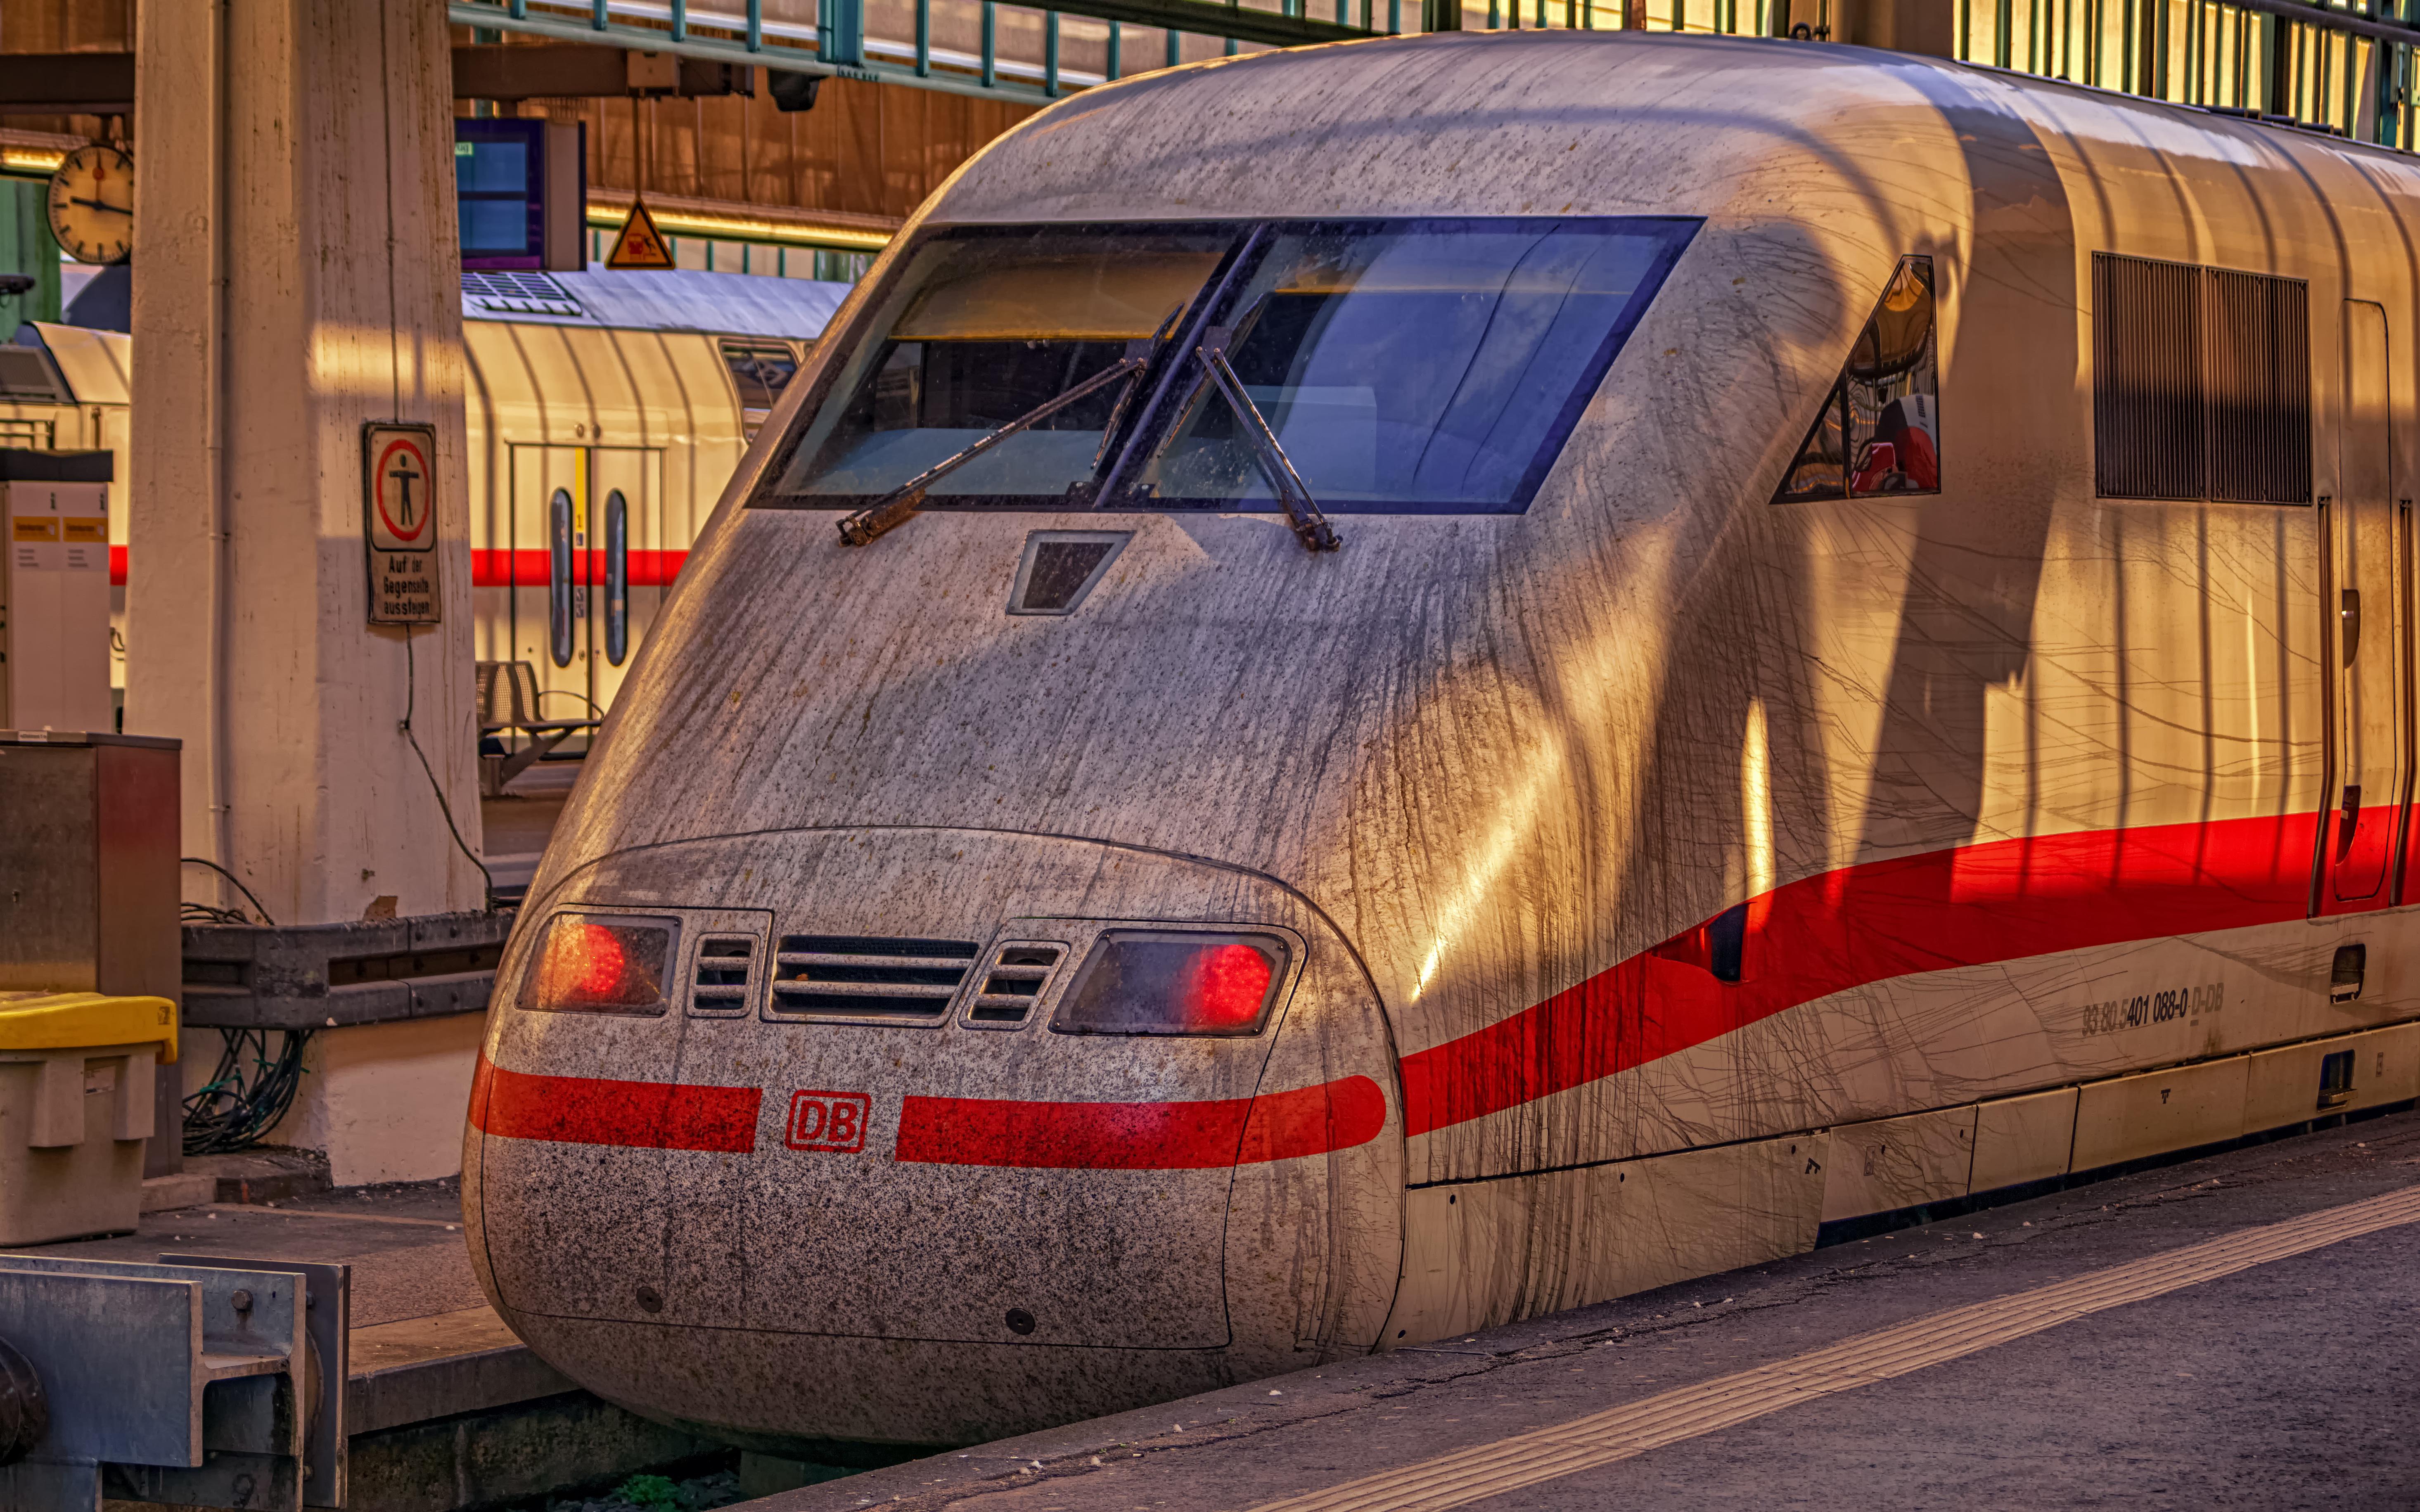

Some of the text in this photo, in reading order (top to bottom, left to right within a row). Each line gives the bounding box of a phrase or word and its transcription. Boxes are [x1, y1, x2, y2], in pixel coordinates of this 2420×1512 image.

[389, 555, 423, 574] Auf der
[384, 576, 430, 599] Gegenseite
[384, 597, 430, 620] aussteigen
[2152, 987, 2189, 1023] 088-0
[2190, 982, 2224, 1016] D-DB
[796, 1100, 858, 1142] DB
